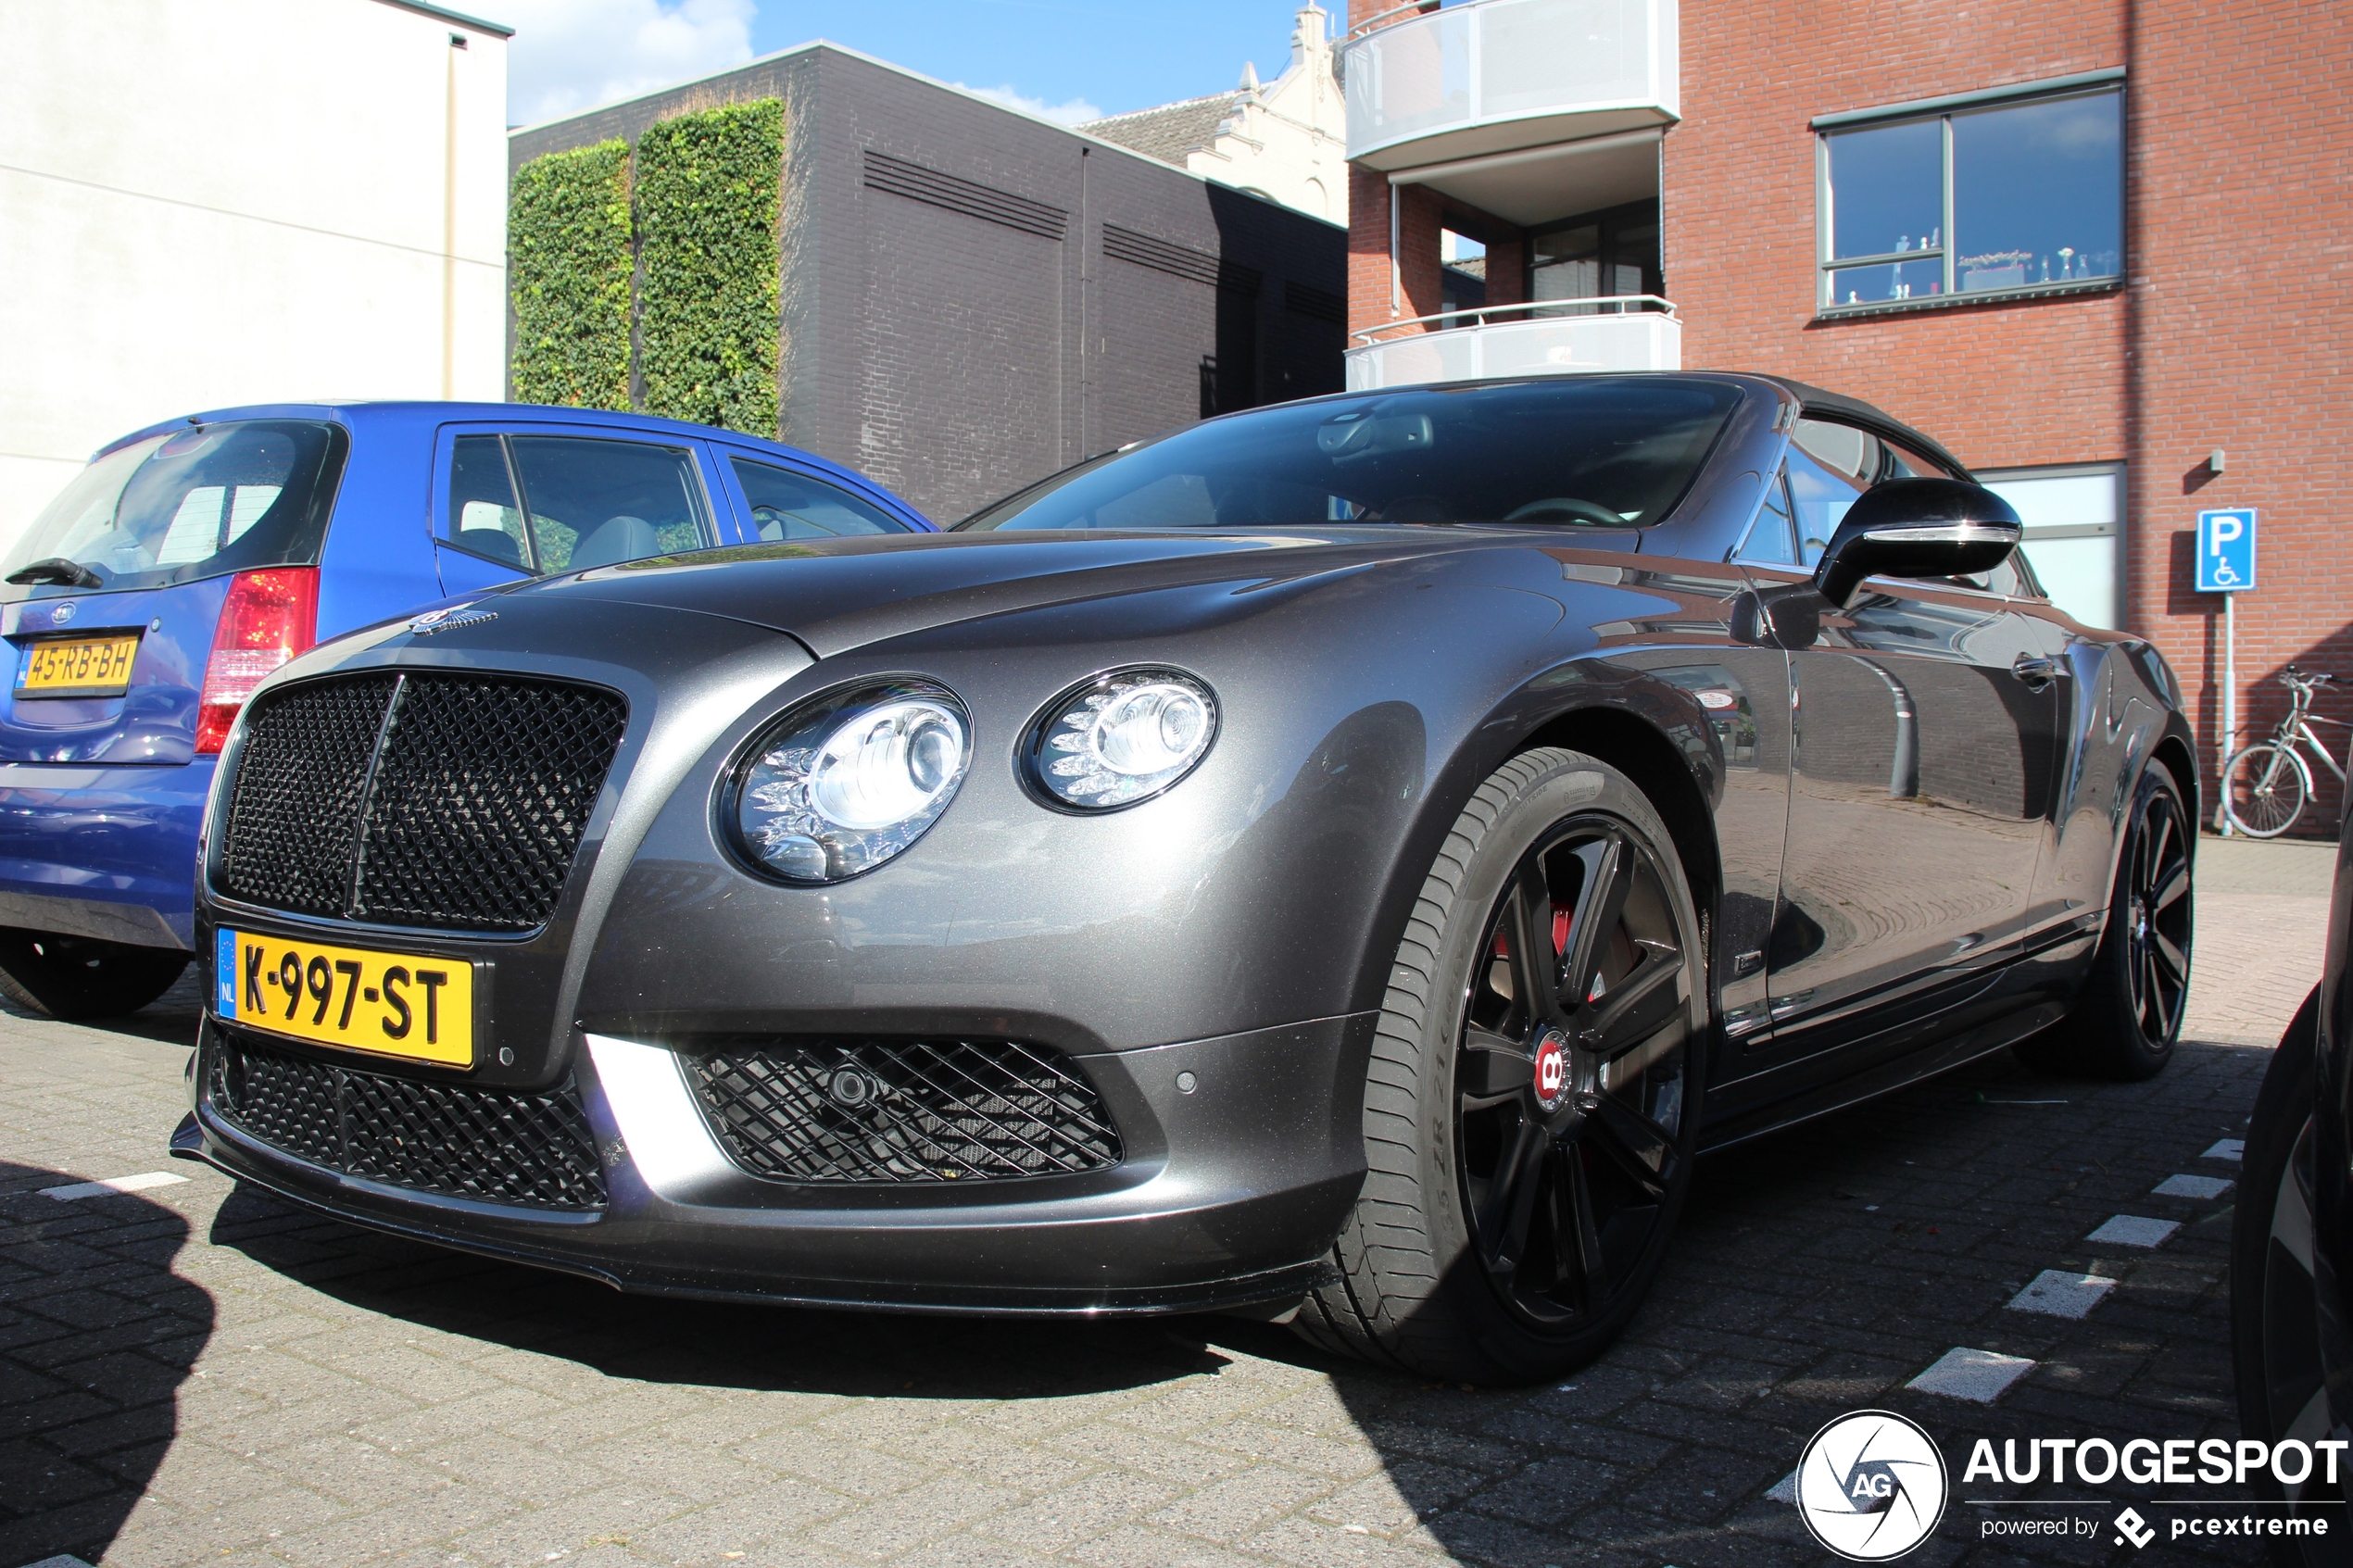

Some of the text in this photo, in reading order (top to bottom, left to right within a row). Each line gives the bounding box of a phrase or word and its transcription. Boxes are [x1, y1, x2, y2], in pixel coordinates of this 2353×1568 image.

[2210, 516, 2243, 557] P
[18, 671, 26, 681] NL
[32, 644, 130, 681] 45-RB-BH
[220, 982, 234, 1003] NL
[245, 944, 447, 1045] K-997-ST
[1432, 1116, 1445, 1176] ZR
